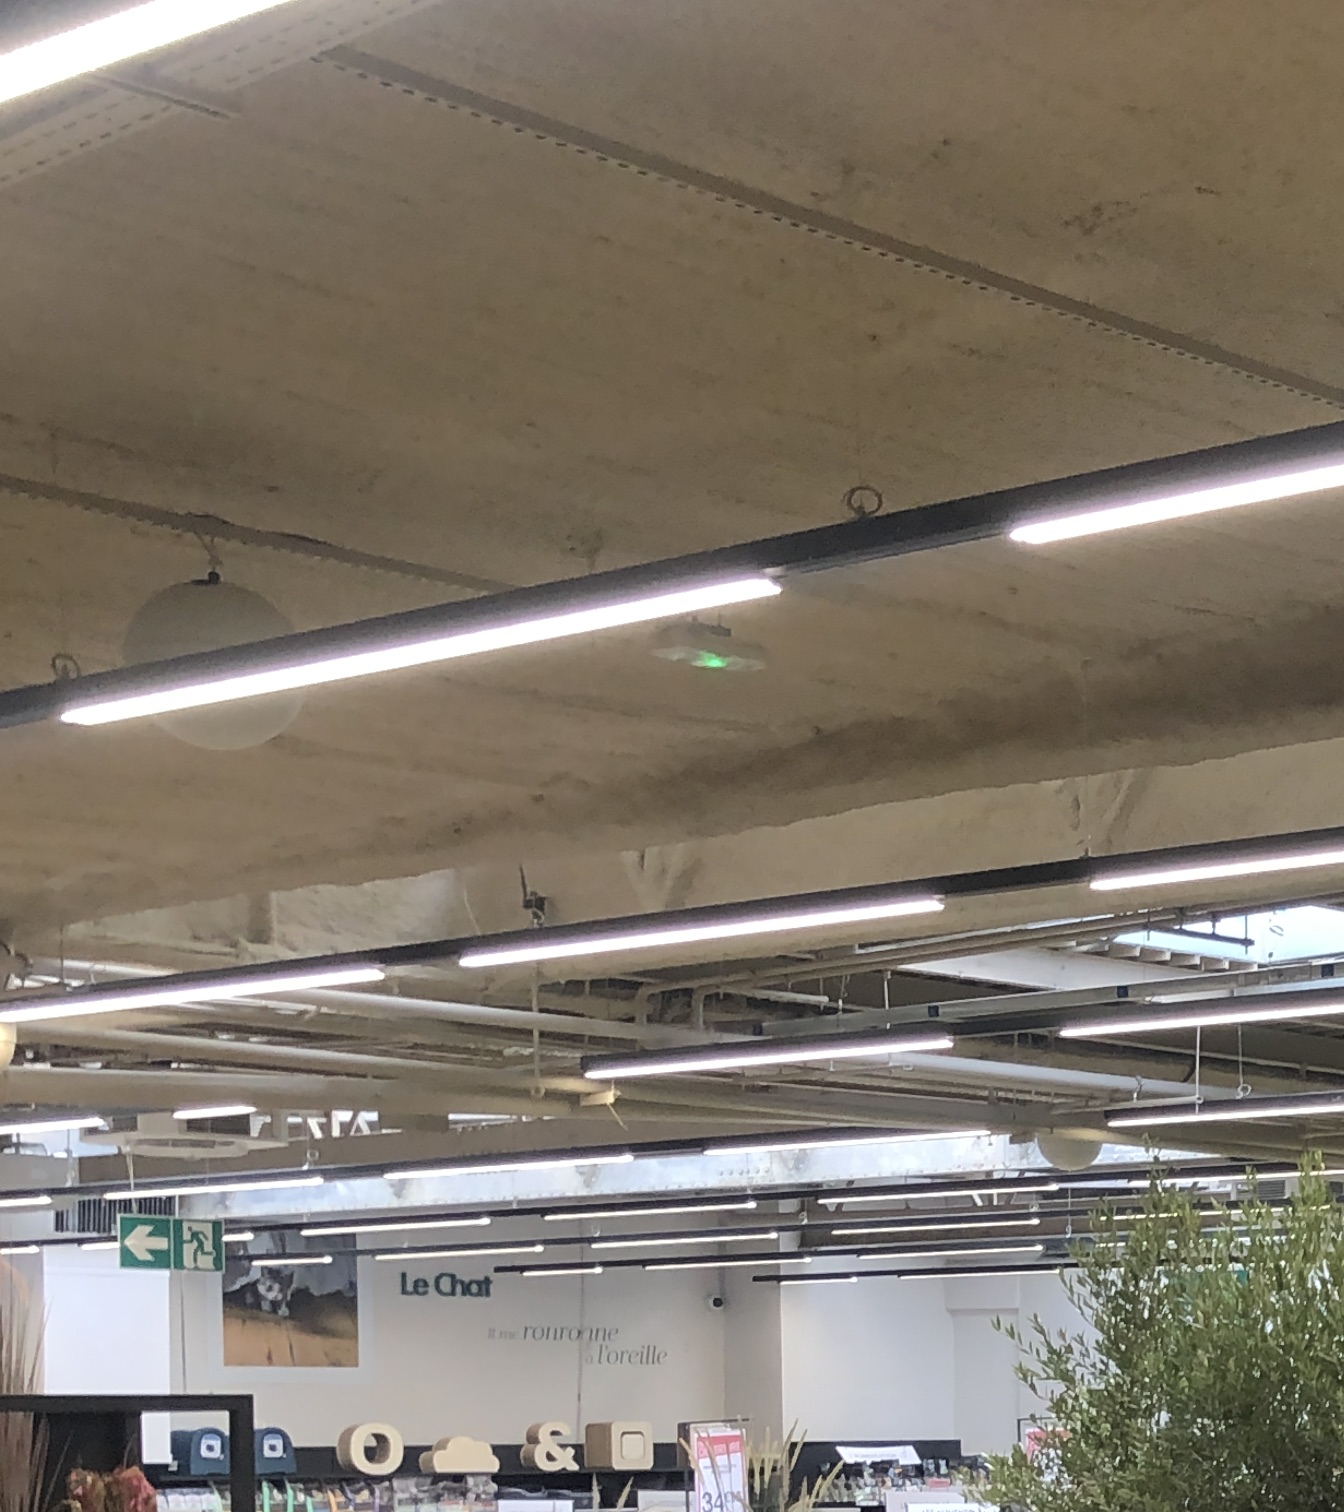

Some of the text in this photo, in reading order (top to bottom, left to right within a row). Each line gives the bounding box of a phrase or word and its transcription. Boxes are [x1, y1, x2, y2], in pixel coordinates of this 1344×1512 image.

[400, 1272, 493, 1298] Le Chat
[523, 1325, 619, 1342] ronronne
[598, 1344, 668, 1366] l'oreille
